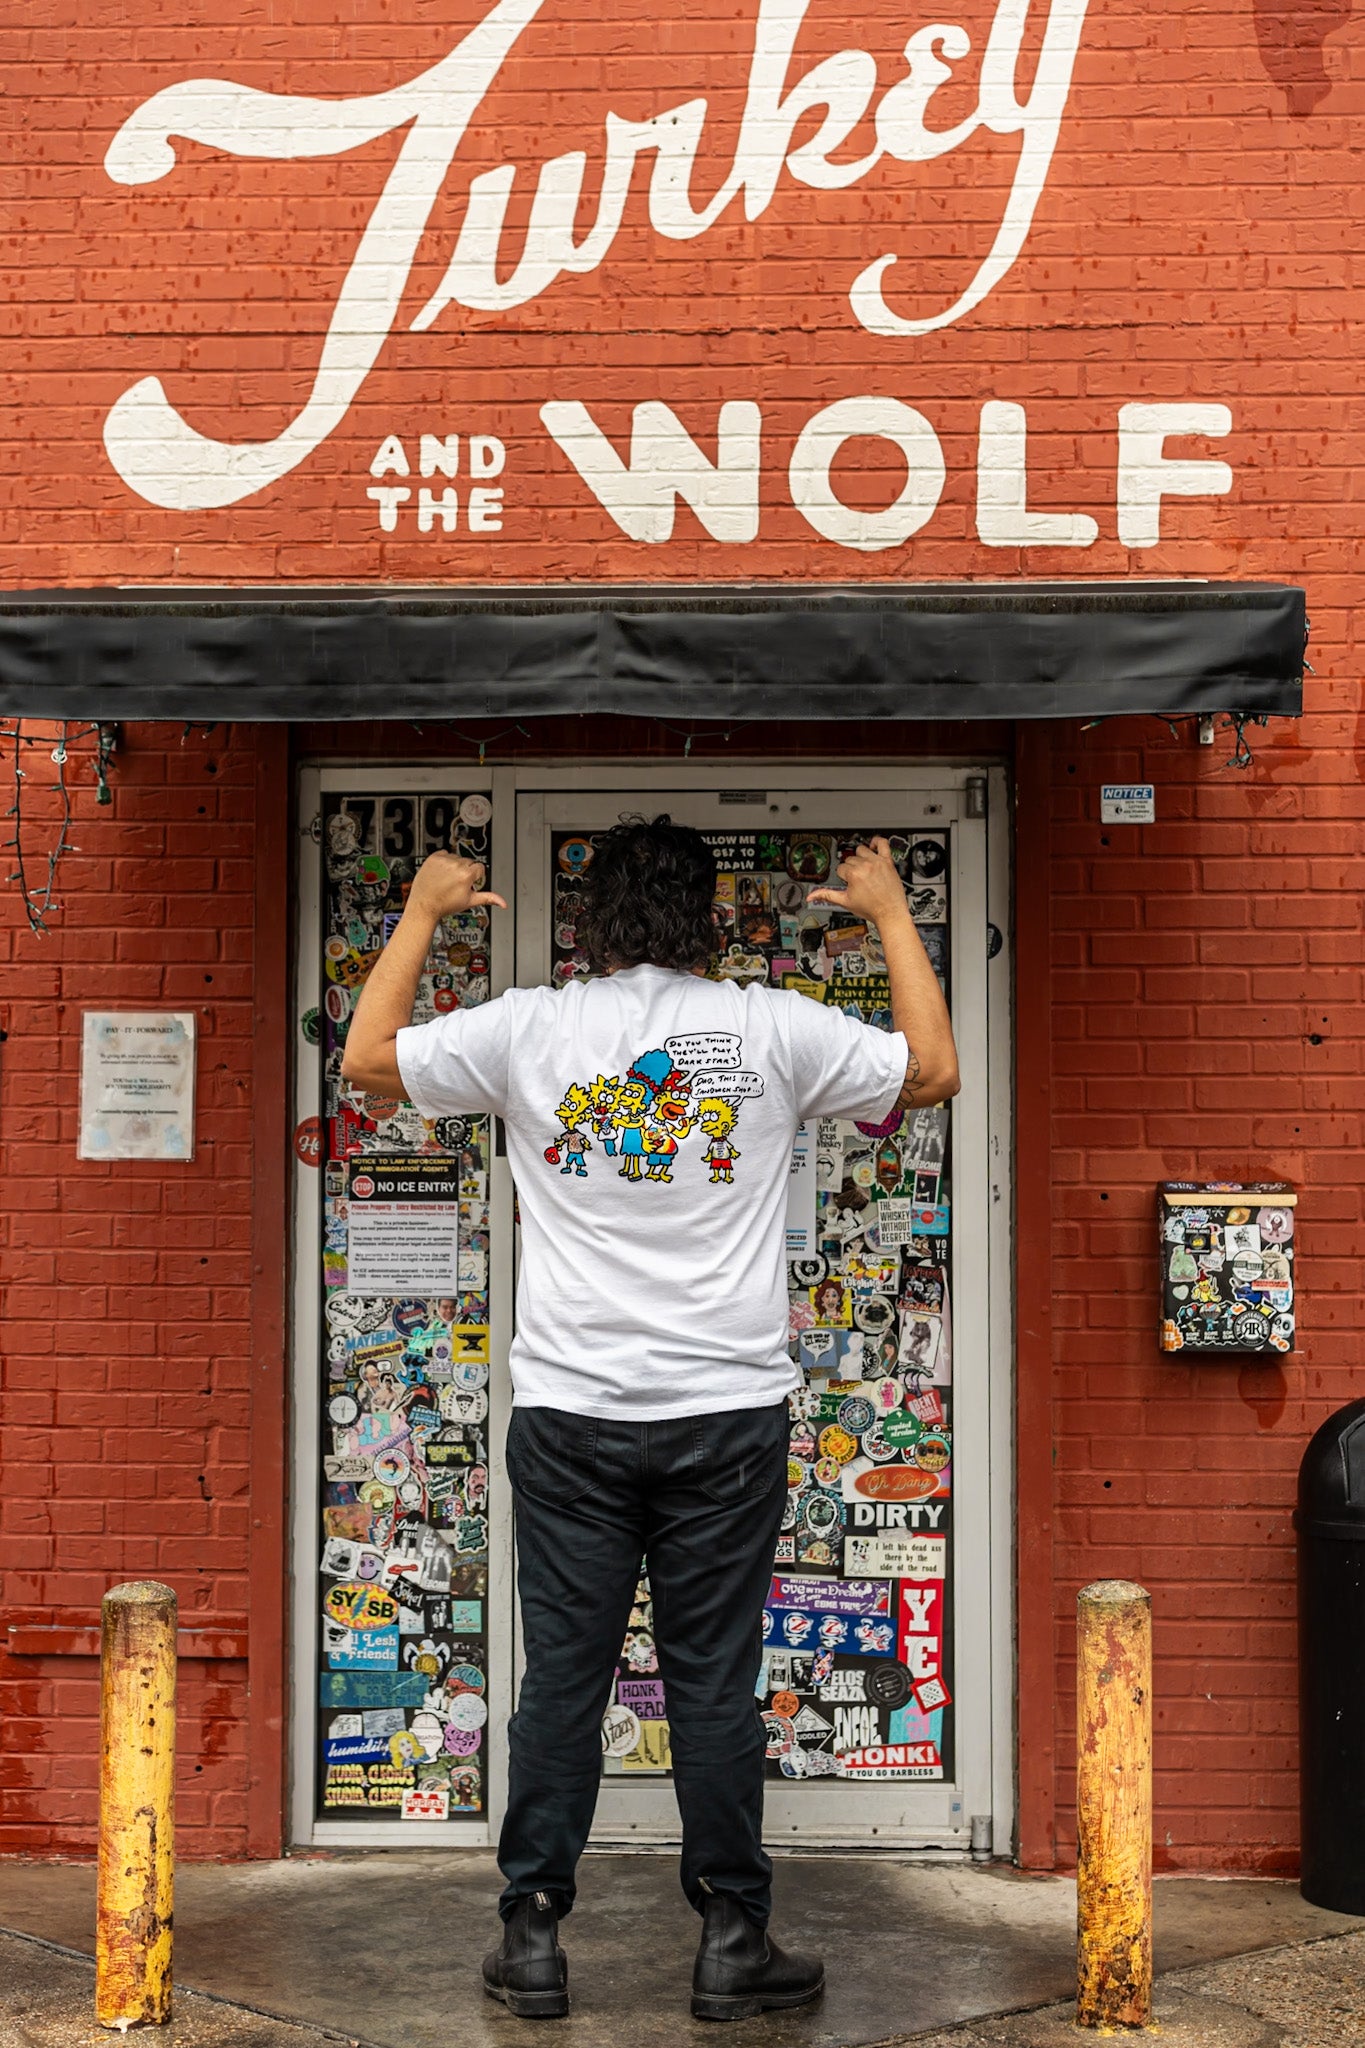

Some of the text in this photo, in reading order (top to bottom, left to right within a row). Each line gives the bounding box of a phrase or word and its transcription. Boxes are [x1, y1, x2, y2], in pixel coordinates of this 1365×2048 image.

[102, 0, 1089, 511] Turkey
[367, 433, 505, 479] AND
[540, 396, 1235, 551] WOLF
[365, 485, 503, 534] THE
[1105, 788, 1150, 798] NOTICE
[739, 835, 756, 845] ME
[712, 848, 755, 857] GET TO
[834, 988, 866, 998] leave
[678, 1057, 702, 1066] DARK
[718, 1074, 736, 1082] THIS
[355, 1182, 371, 1191] STOP
[377, 1182, 456, 1192] NO ICE ENTRY
[879, 1201, 892, 1211] THE
[880, 1211, 910, 1221] WHISKEY
[880, 1221, 911, 1231] WITHOUT
[881, 1232, 911, 1243] REGRETS
[935, 1239, 947, 1249] VO
[935, 1249, 947, 1260] TE
[854, 1503, 944, 1528] DIRTY
[882, 1542, 894, 1552] left
[911, 1542, 927, 1552] dead
[884, 1553, 928, 1563] there by the
[879, 1564, 937, 1573] side of the road
[331, 1590, 358, 1607] SY
[367, 1601, 394, 1618] SB
[362, 1633, 396, 1647] Lesh
[345, 1647, 397, 1660] Friends
[622, 1684, 658, 1698] HONK
[845, 1747, 935, 1765] HONK!
[846, 1769, 854, 1777] IF
[857, 1769, 874, 1777] YOU
[890, 1768, 934, 1776] BARBLESS
[405, 1799, 445, 1808] MORGAN
